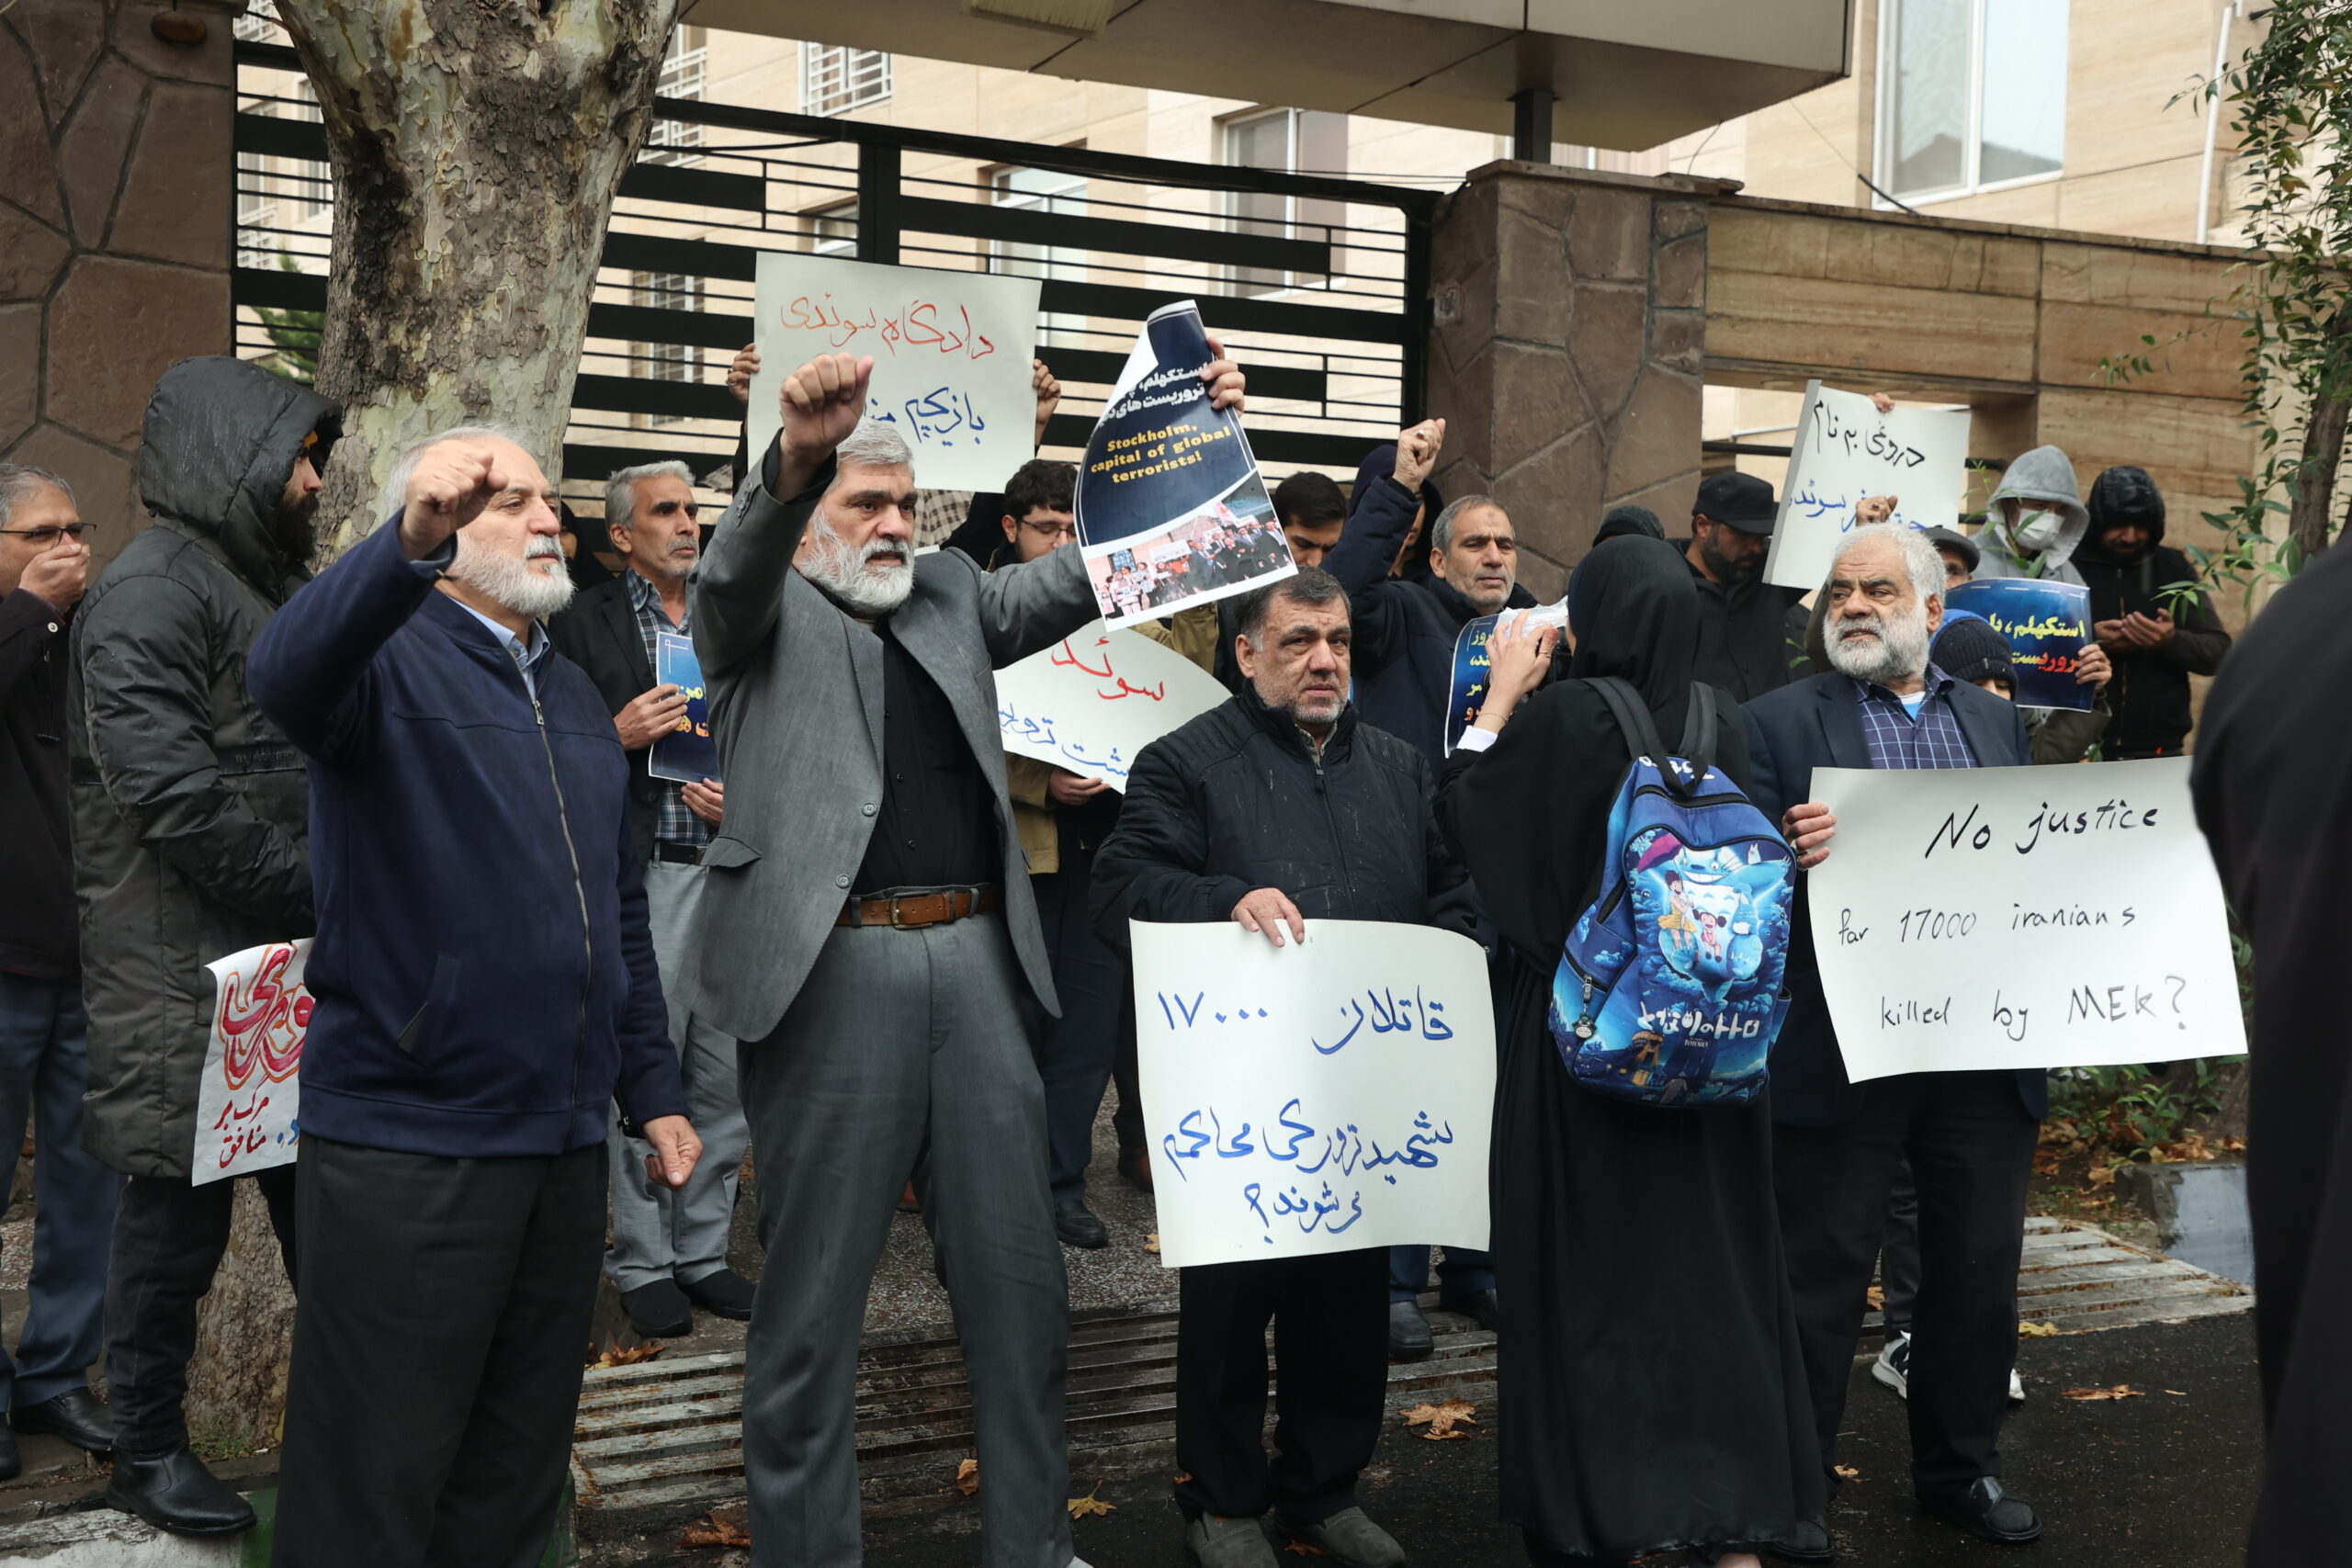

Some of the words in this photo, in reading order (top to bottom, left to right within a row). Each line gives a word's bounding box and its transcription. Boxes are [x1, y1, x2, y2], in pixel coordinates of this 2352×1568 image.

[881, 299, 995, 359] دادگاه
[1090, 449, 1141, 473] capital
[1147, 444, 1166, 458] of
[1172, 425, 1232, 454] global
[1107, 423, 1198, 452] Stockholm,
[1813, 400, 1839, 454] نام
[1843, 427, 1858, 457] به
[1112, 450, 1203, 484] terrorists!
[2012, 652, 2081, 673] روریست
[1925, 804, 1992, 859] No
[2015, 798, 2159, 854] justice
[1900, 908, 1977, 942] 17000
[2012, 902, 2137, 931] iranians
[1311, 984, 1453, 1055] قاتلان
[1637, 1000, 1760, 1040] となりのトトロ
[1881, 996, 1951, 1030] killed
[1992, 989, 2029, 1042] by
